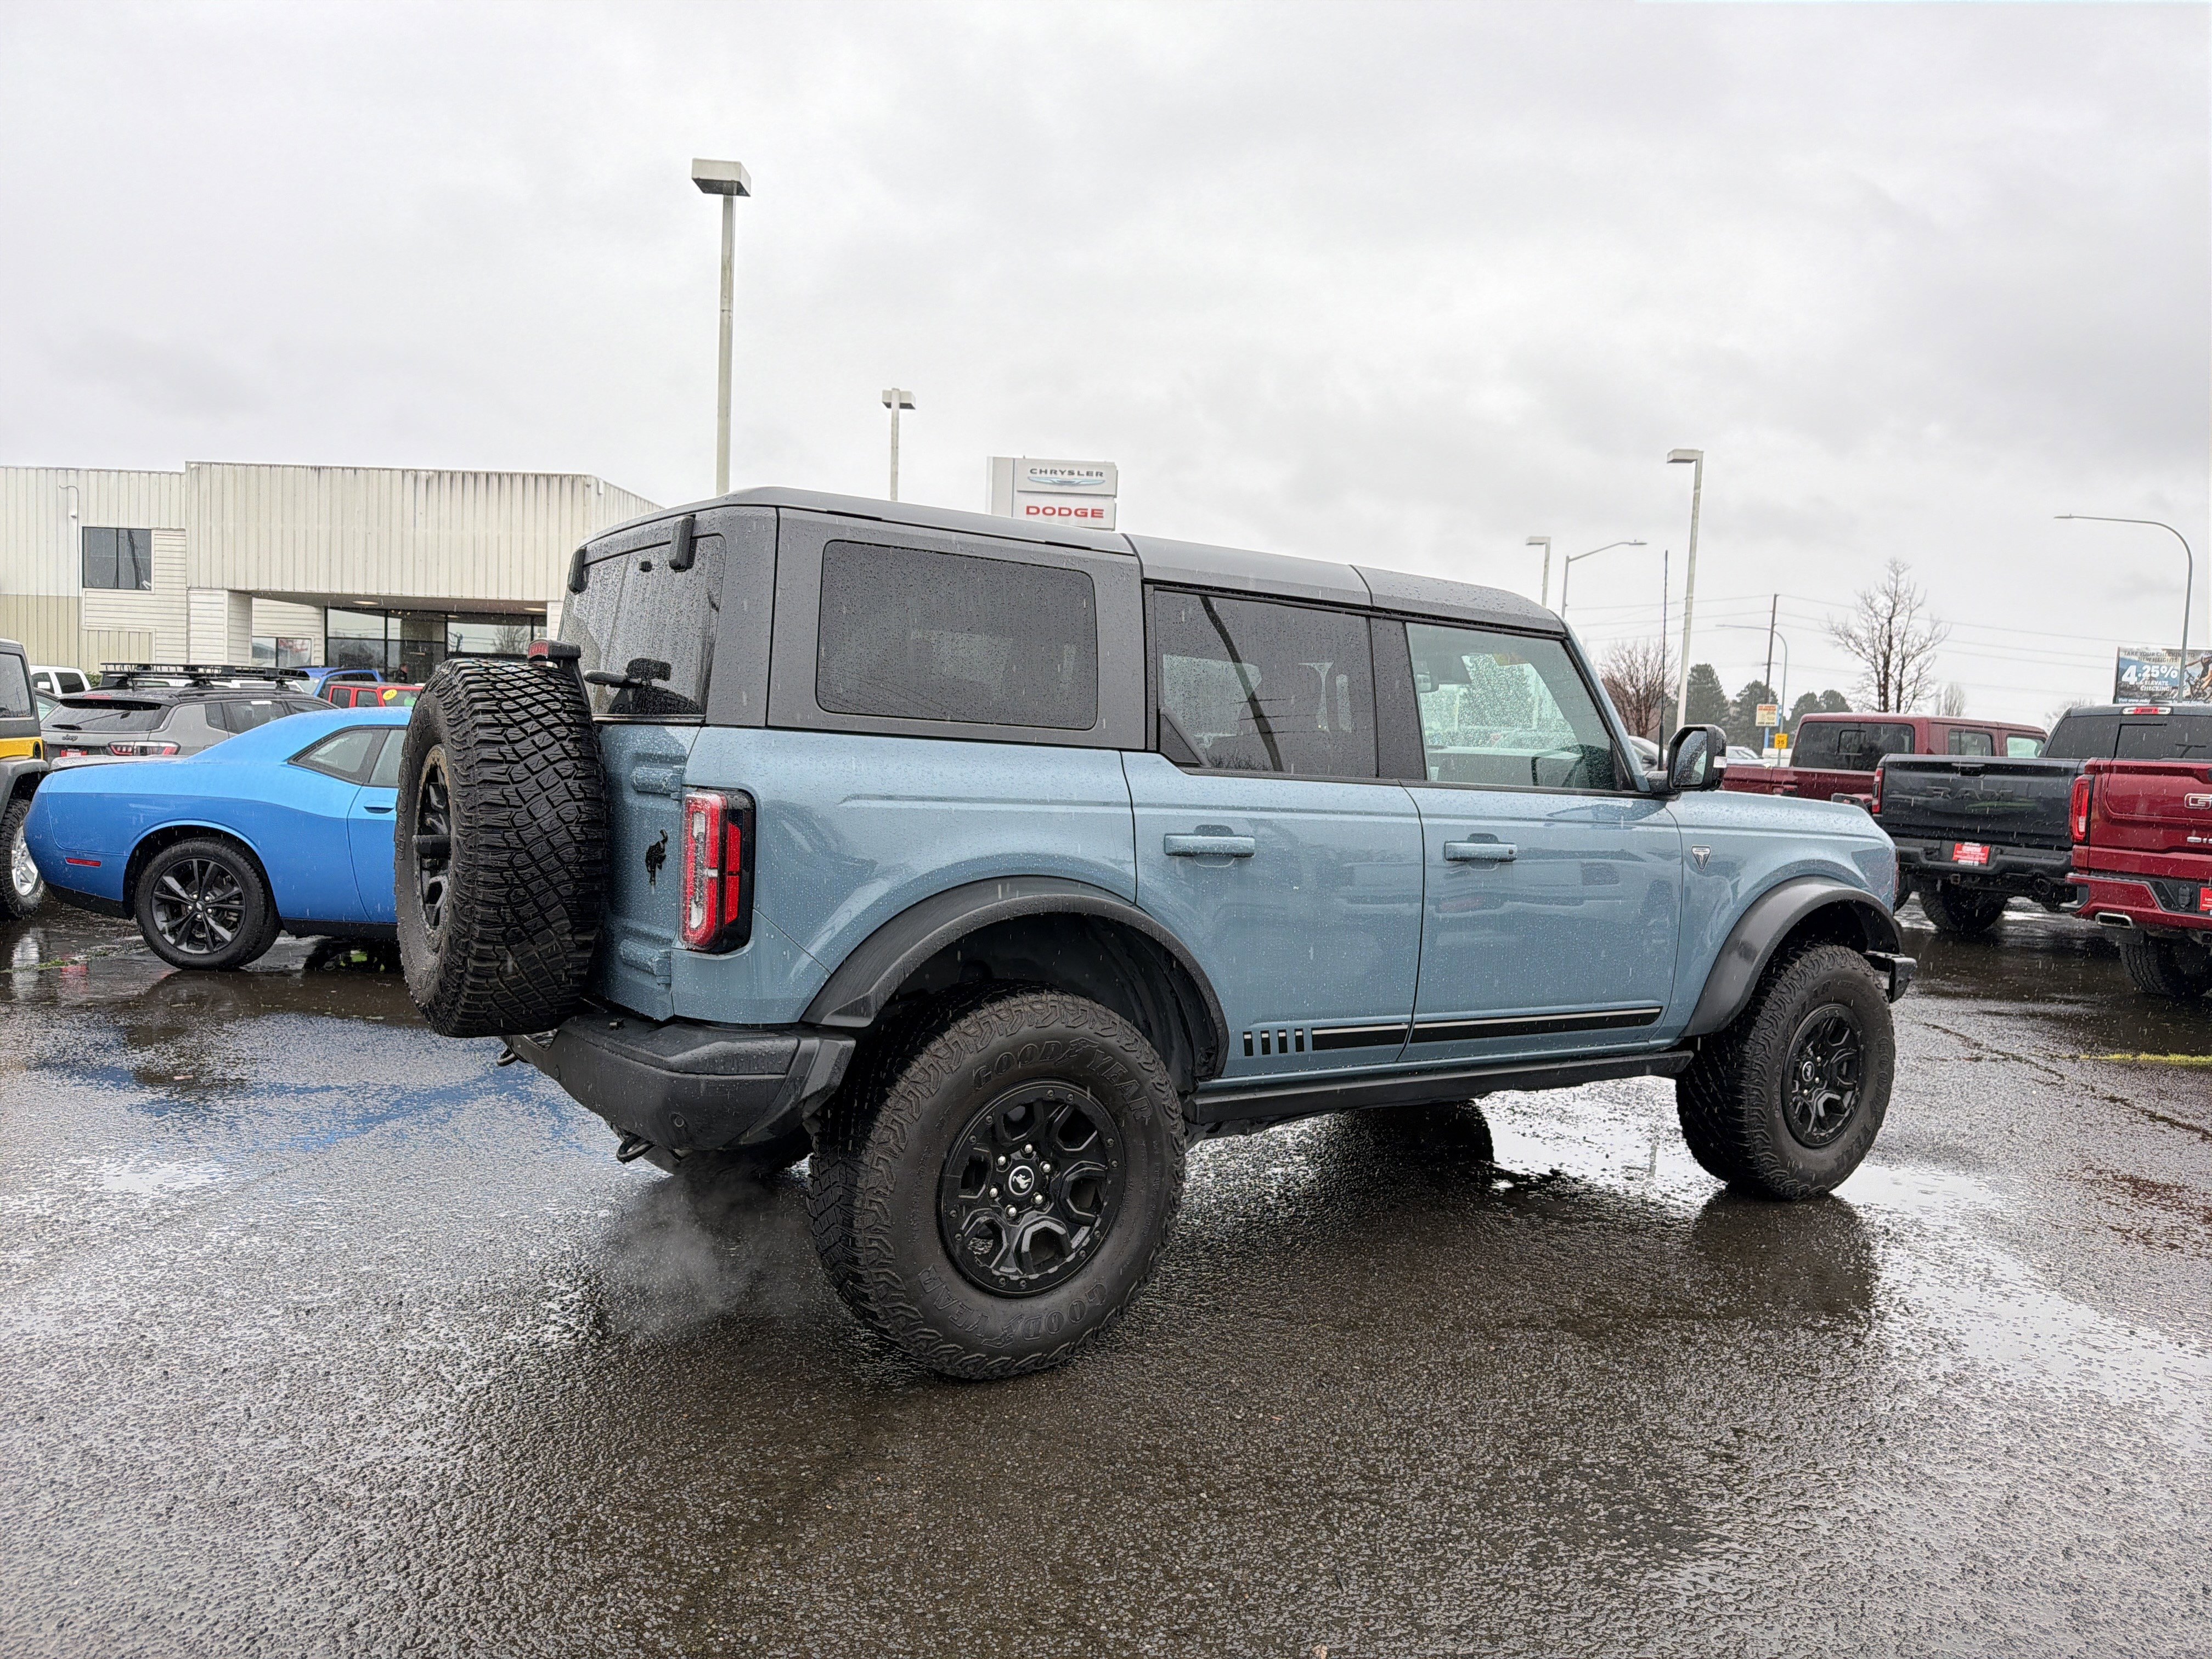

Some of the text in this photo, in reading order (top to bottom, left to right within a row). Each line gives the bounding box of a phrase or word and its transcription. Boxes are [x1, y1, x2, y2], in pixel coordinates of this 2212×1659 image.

[1029, 468, 1104, 477] CHRYSLER
[1026, 505, 1104, 518] DODGE
[2121, 665, 2178, 685] 4.25%
